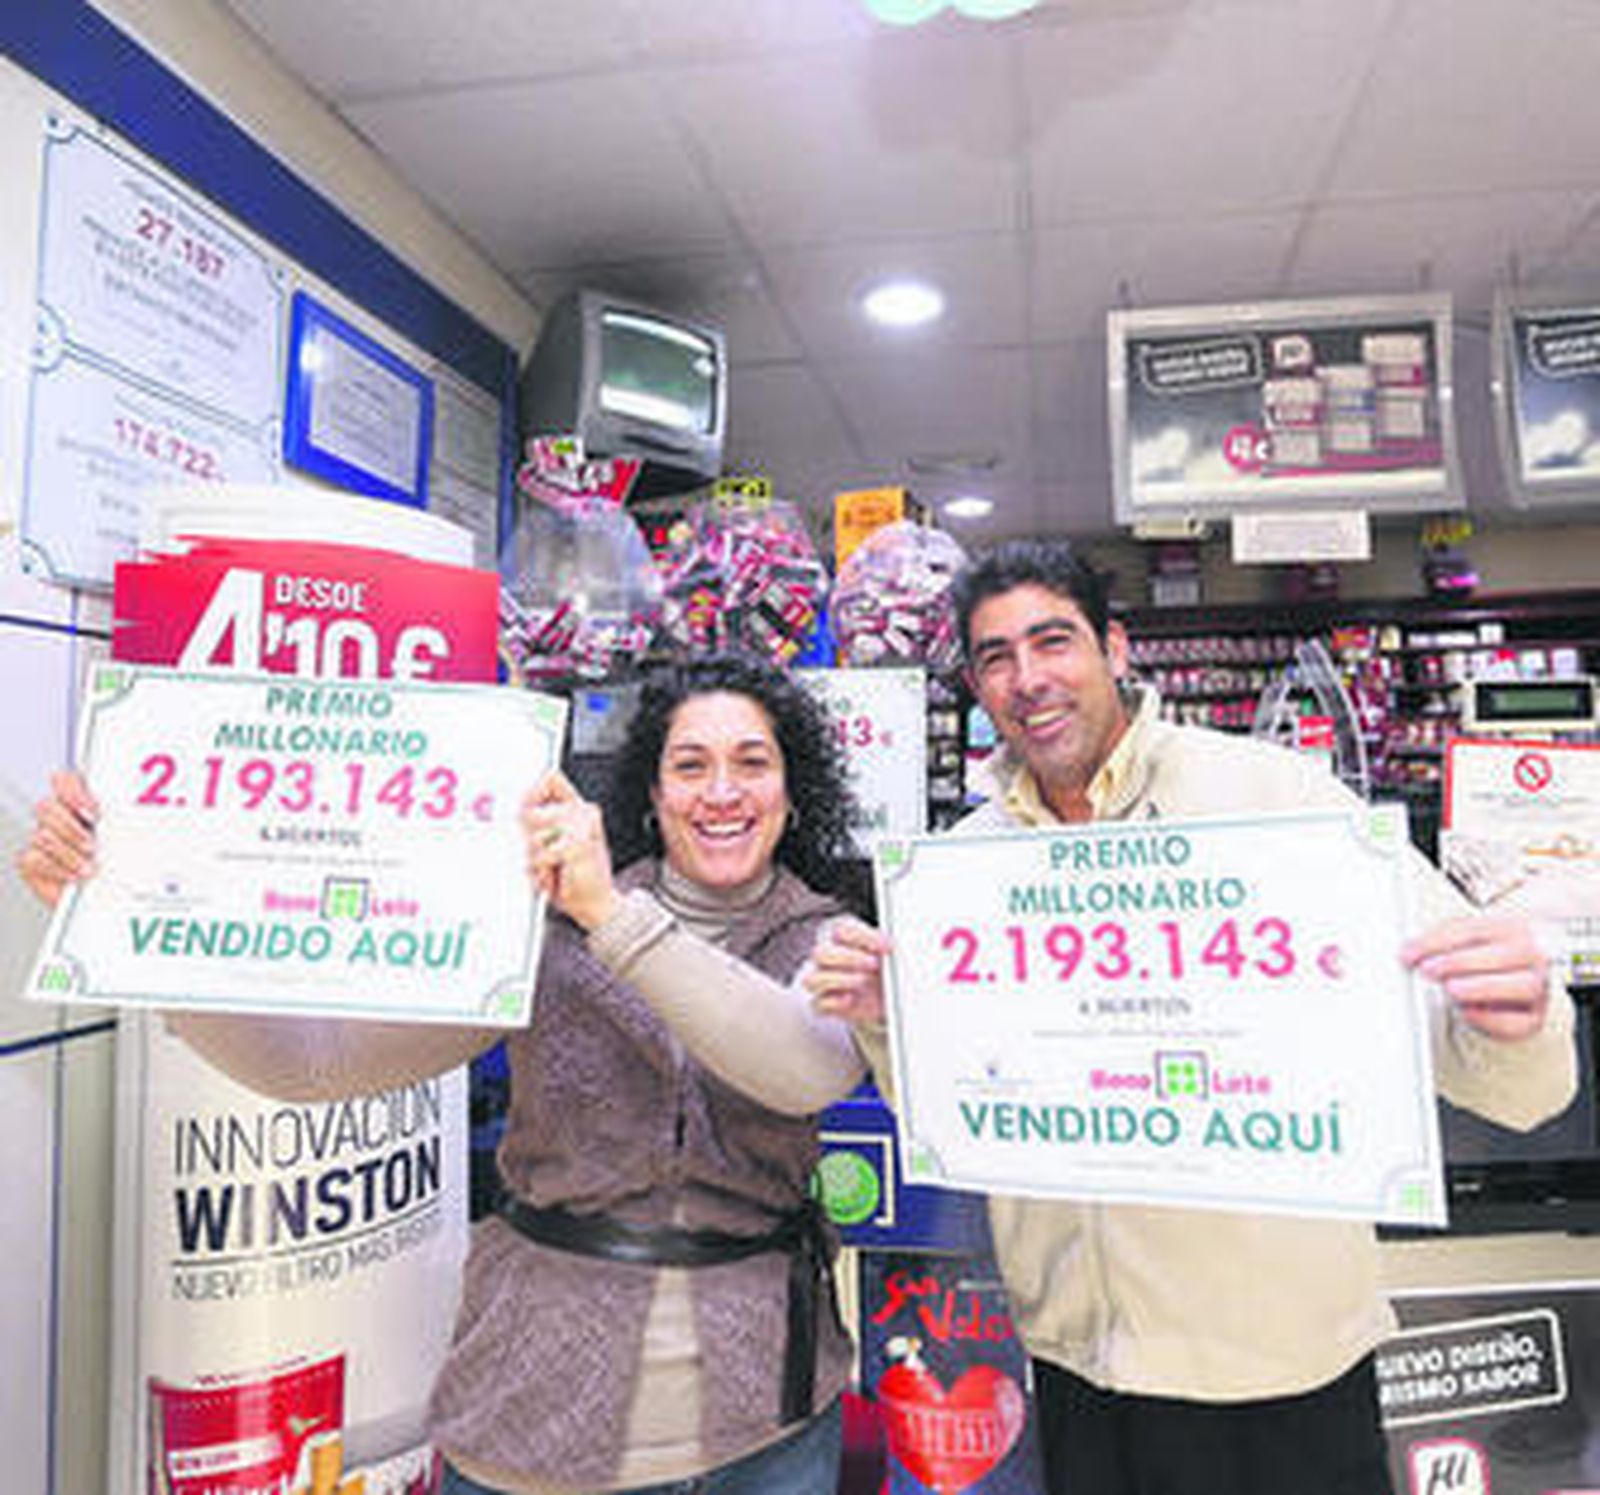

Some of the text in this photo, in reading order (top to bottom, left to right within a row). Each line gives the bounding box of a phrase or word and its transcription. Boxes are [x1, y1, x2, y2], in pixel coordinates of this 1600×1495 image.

[264, 687, 393, 718] PREMIO
[214, 722, 428, 758] MILLONARIO
[136, 753, 460, 822] 2.193.143
[1050, 834, 1192, 870] PREMIO
[1008, 877, 1247, 914] MILLONARIO
[129, 916, 470, 969] VENDIDO AQUÍ
[941, 917, 1298, 983] 2.193.143
[959, 1101, 1342, 1155] VENDIDO AQUÍ
[174, 1136, 441, 1253] WINSTON
[1463, 1361, 1541, 1395] SABOR
